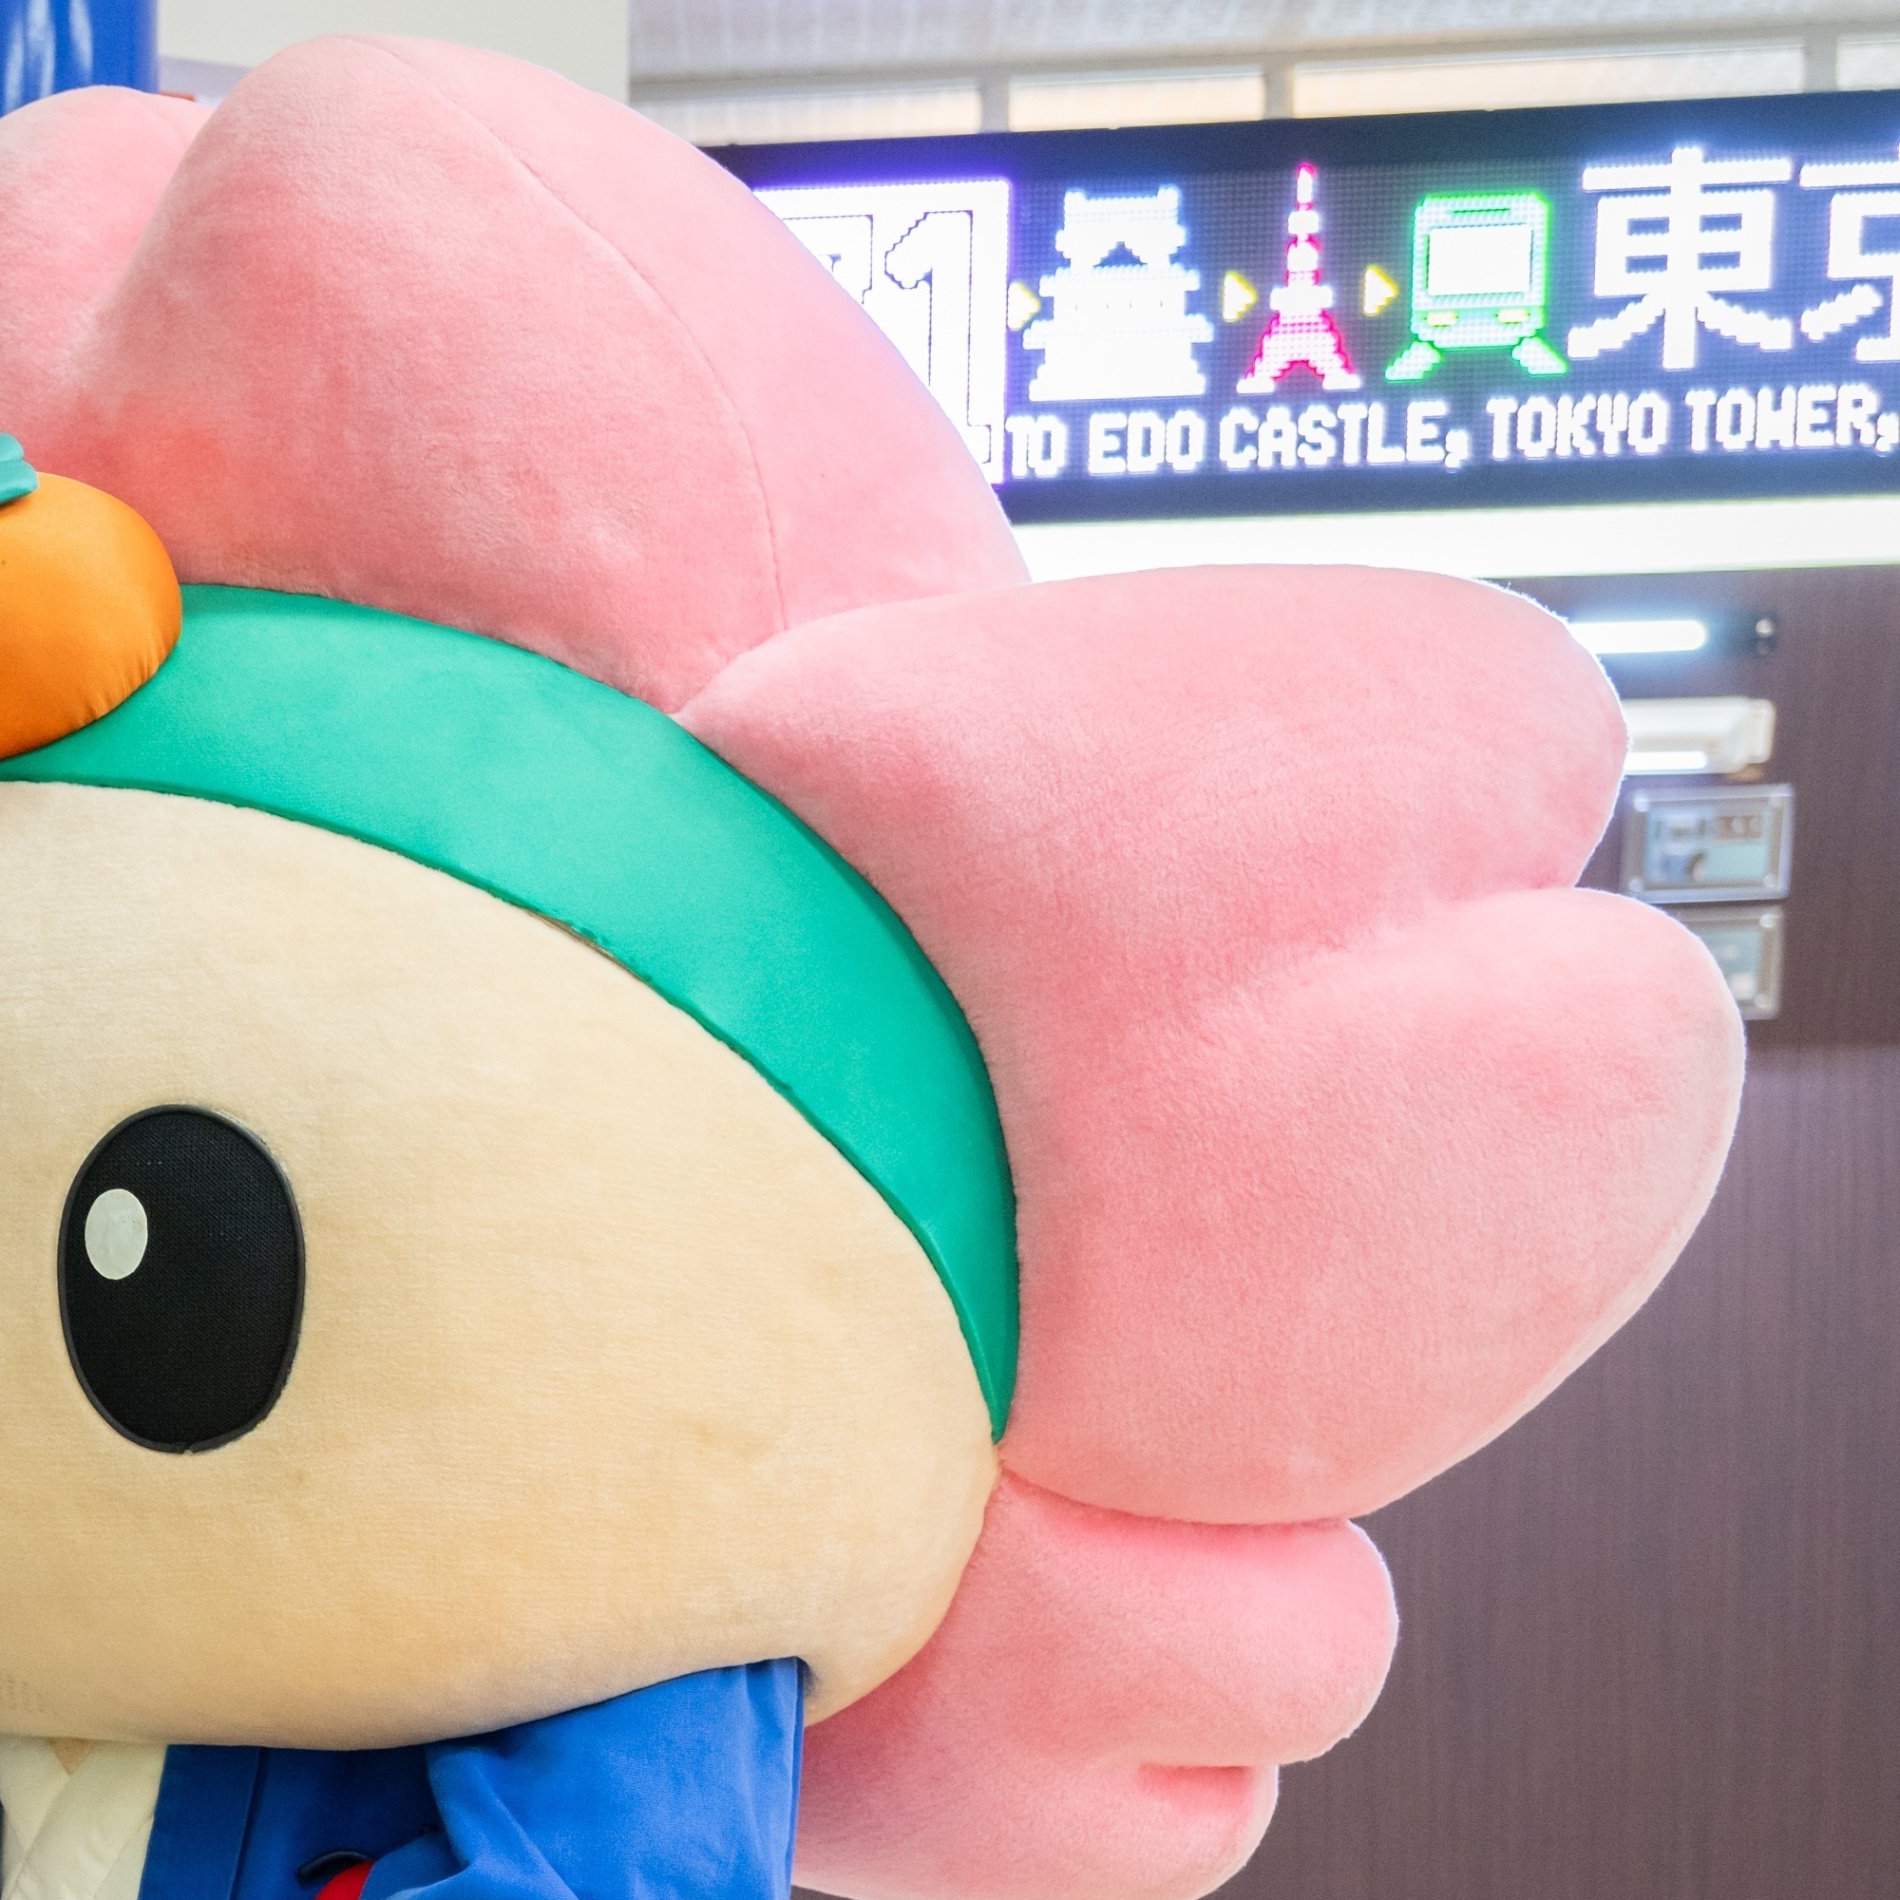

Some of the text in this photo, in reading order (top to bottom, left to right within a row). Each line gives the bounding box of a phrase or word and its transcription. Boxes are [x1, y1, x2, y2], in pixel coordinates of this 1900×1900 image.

[1005, 383, 1900, 478] TO EDO CASTLE, TOKYO TOWER,
